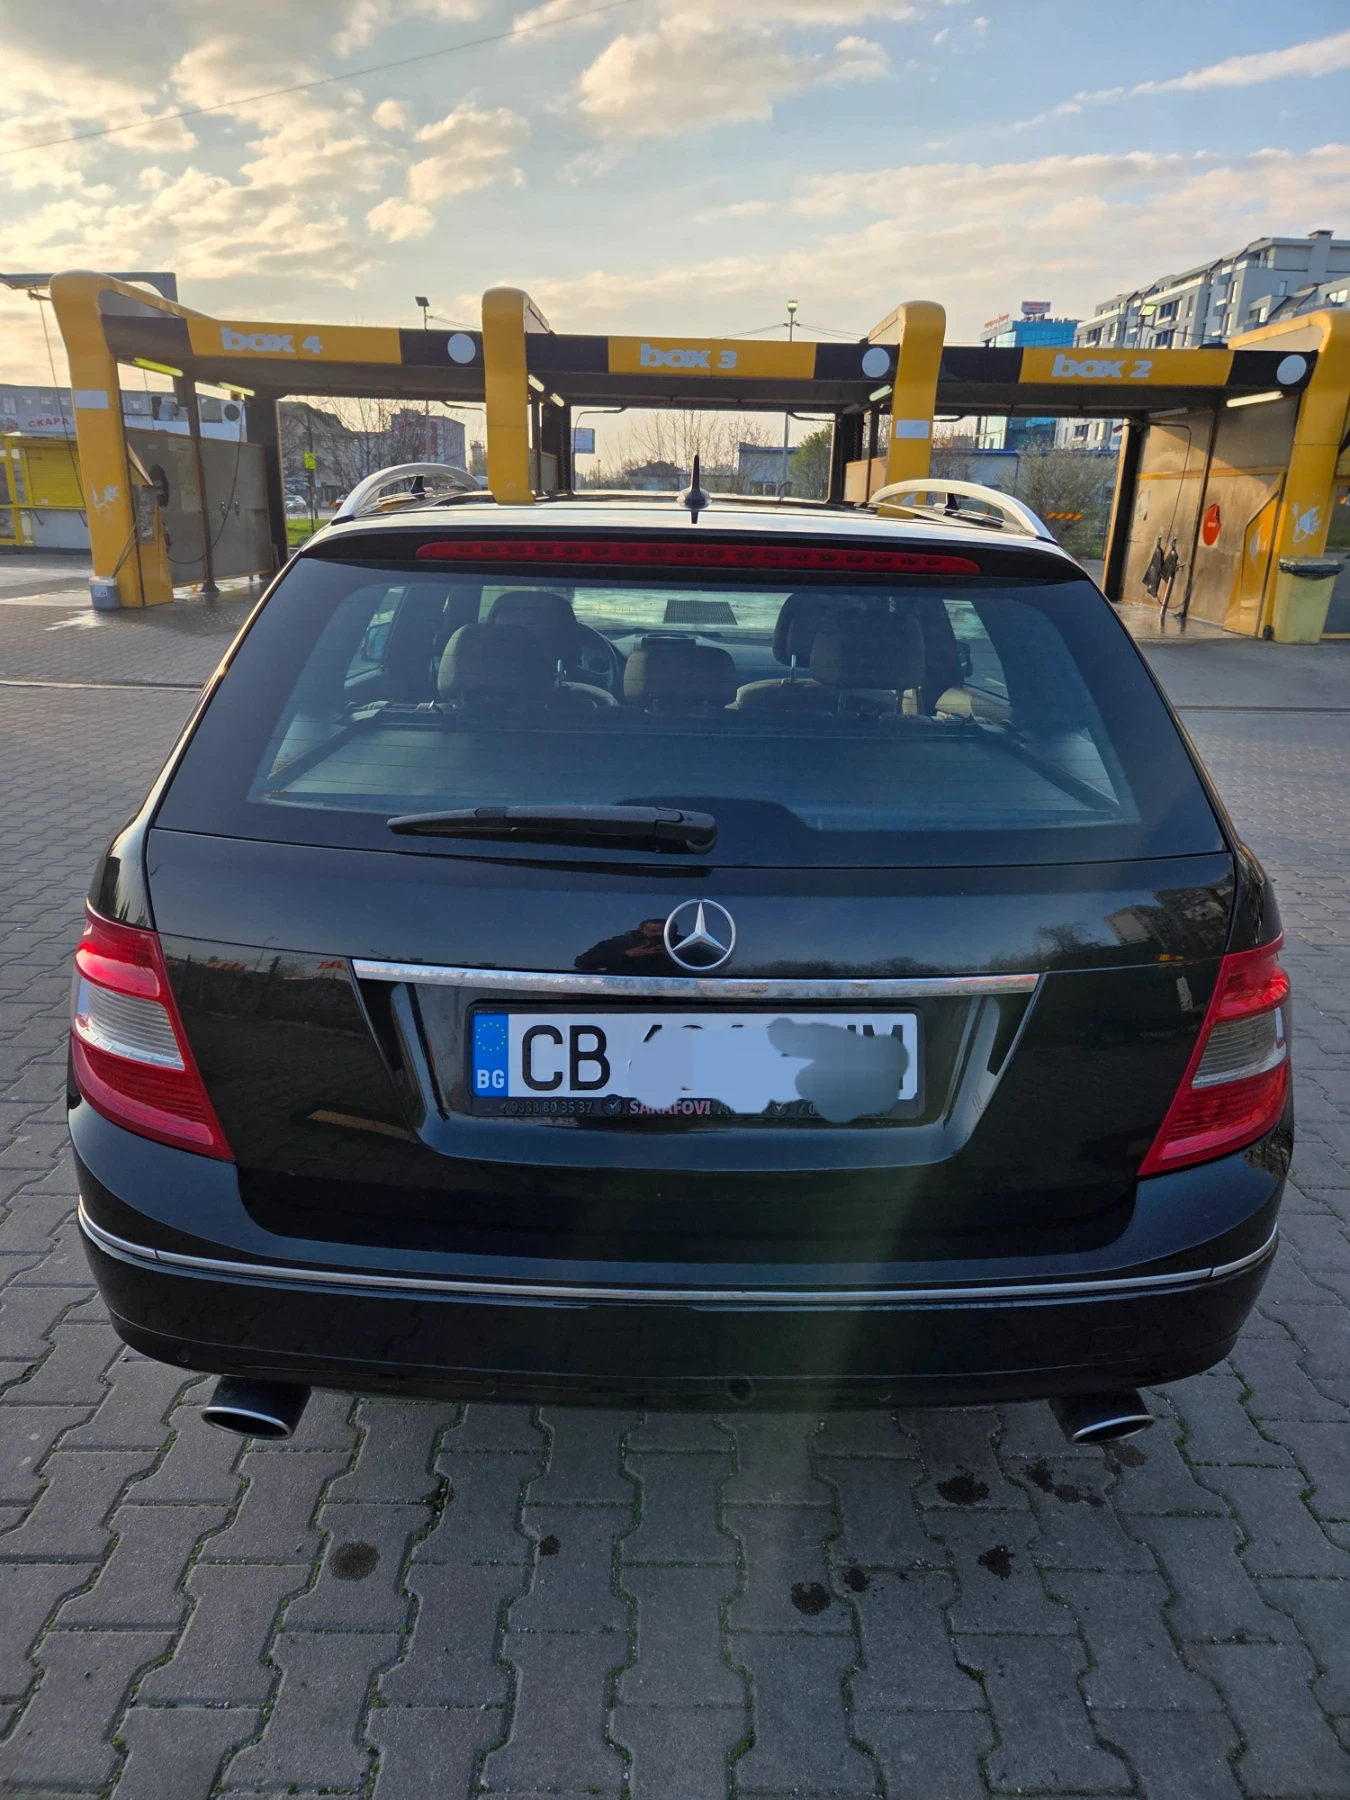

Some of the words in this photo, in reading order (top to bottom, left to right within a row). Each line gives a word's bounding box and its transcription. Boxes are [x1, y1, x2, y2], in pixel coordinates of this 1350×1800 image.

[221, 326, 295, 353] box
[302, 335, 323, 354] 4
[640, 343, 712, 369] box
[718, 350, 737, 369] 3
[1051, 353, 1126, 378] box
[1130, 359, 1153, 378] 2
[522, 1024, 611, 1091] CB
[476, 1069, 505, 1089] BG
